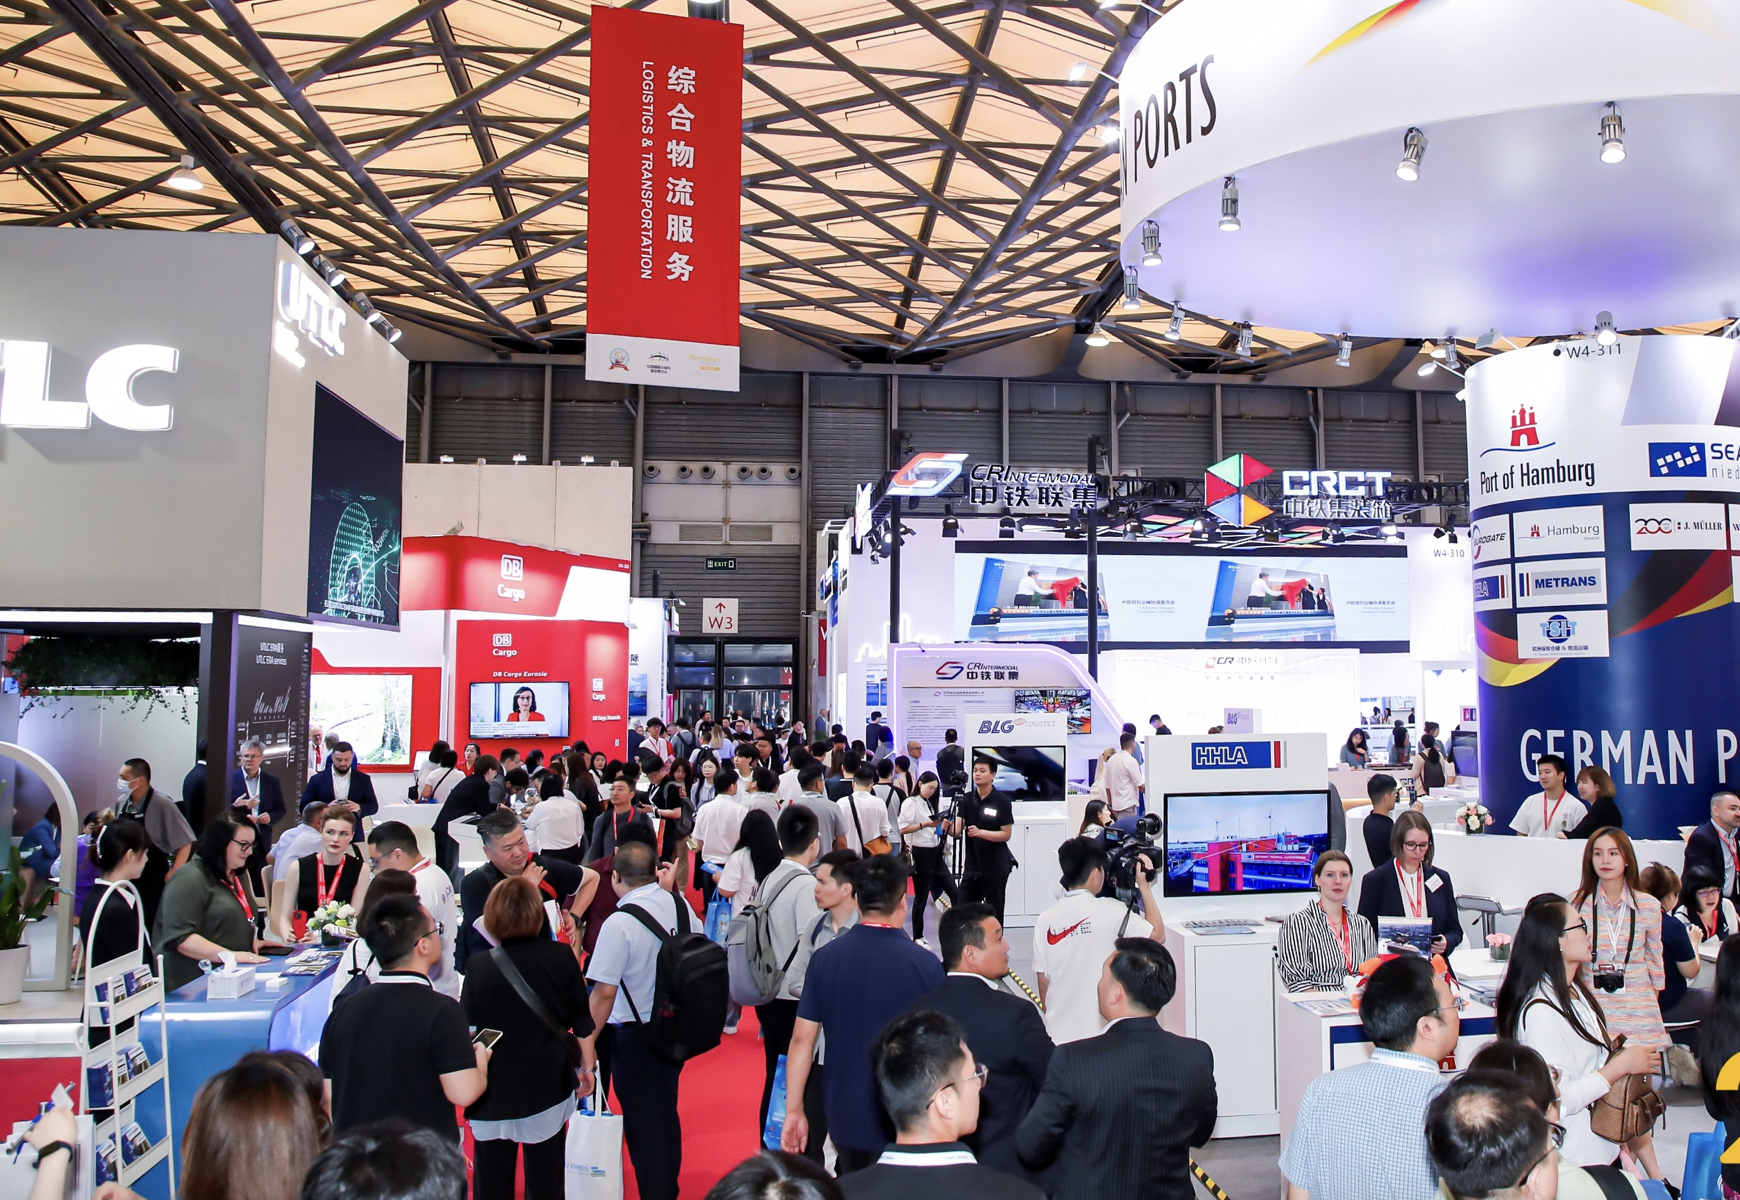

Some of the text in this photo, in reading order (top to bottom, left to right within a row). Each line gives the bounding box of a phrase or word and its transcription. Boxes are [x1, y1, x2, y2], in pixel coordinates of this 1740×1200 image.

[1134, 54, 1217, 183] PORTS
[640, 61, 654, 279] LOGISTICS & TRANSPORTATION
[666, 65, 696, 282] 综合物流服务
[1566, 343, 1622, 358] W4-311
[0, 340, 179, 431] LC
[1282, 470, 1392, 496] CRCT
[1480, 459, 1596, 495] Port of Hamburg
[970, 485, 1097, 510] 中铁联集
[1282, 498, 1393, 519] 中铁集装箱
[1547, 524, 1600, 537] Hamburg
[1692, 520, 1722, 530] MÜLLER
[1474, 532, 1506, 546] EUROGATE
[1433, 549, 1465, 558] W4-310
[503, 557, 522, 578] DB
[1534, 575, 1597, 589] METRANS
[498, 584, 526, 602] Cargo
[708, 616, 733, 630] W3
[494, 634, 510, 646] DB
[492, 648, 518, 658] Cargo
[966, 671, 1019, 680] 中铁联集
[978, 720, 1014, 734] BLG
[1195, 746, 1248, 766] HHLA
[1520, 728, 1695, 784] GERMAN
